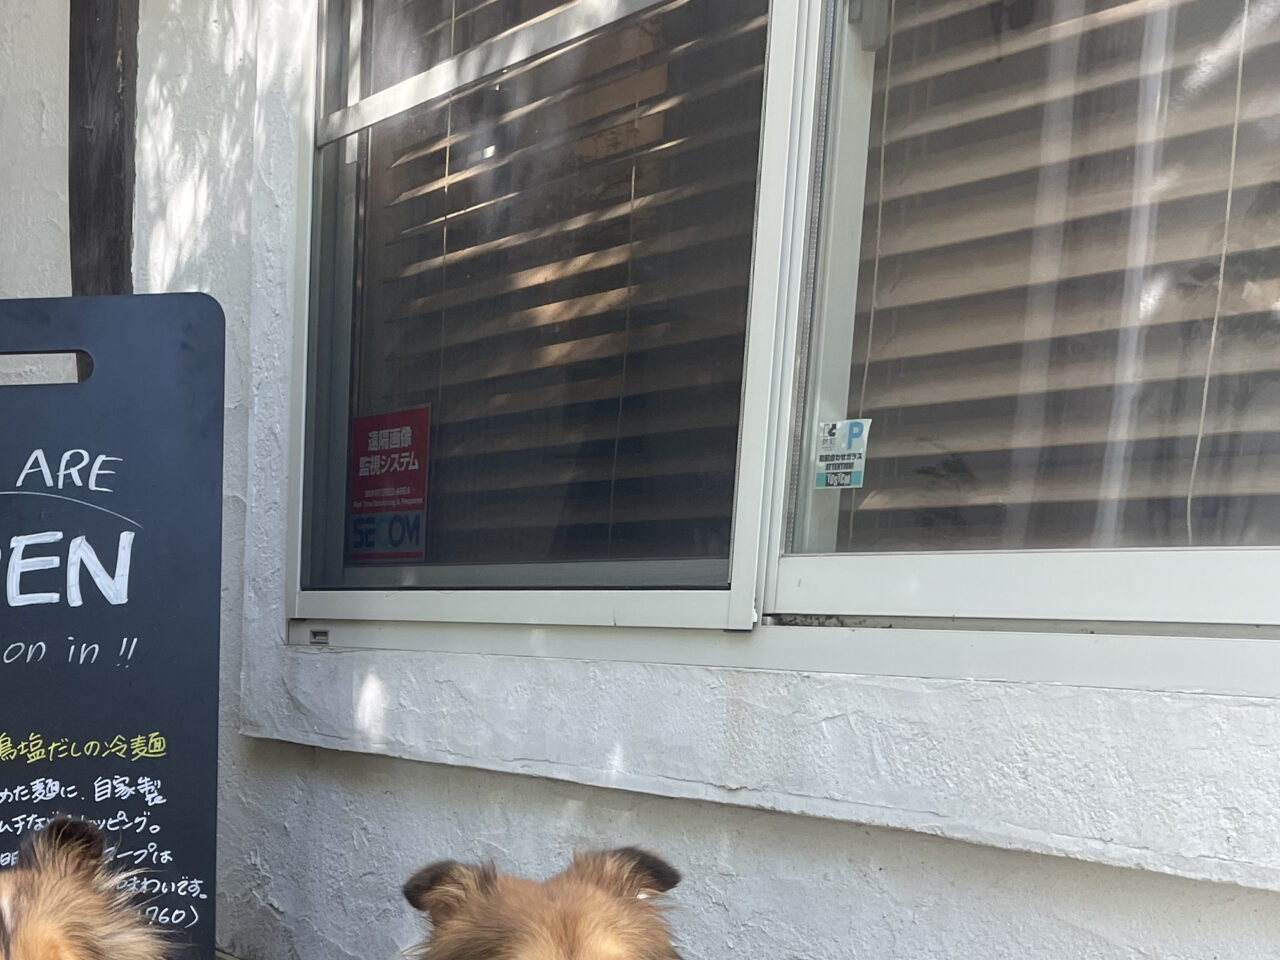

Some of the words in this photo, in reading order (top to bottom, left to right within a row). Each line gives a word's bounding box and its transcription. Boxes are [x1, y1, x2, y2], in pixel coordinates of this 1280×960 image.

[16, 449, 123, 492] ARE
[358, 452, 419, 477] 監視システム
[352, 513, 421, 548] SECOM
[3, 640, 47, 664] on
[67, 636, 99, 664] in
